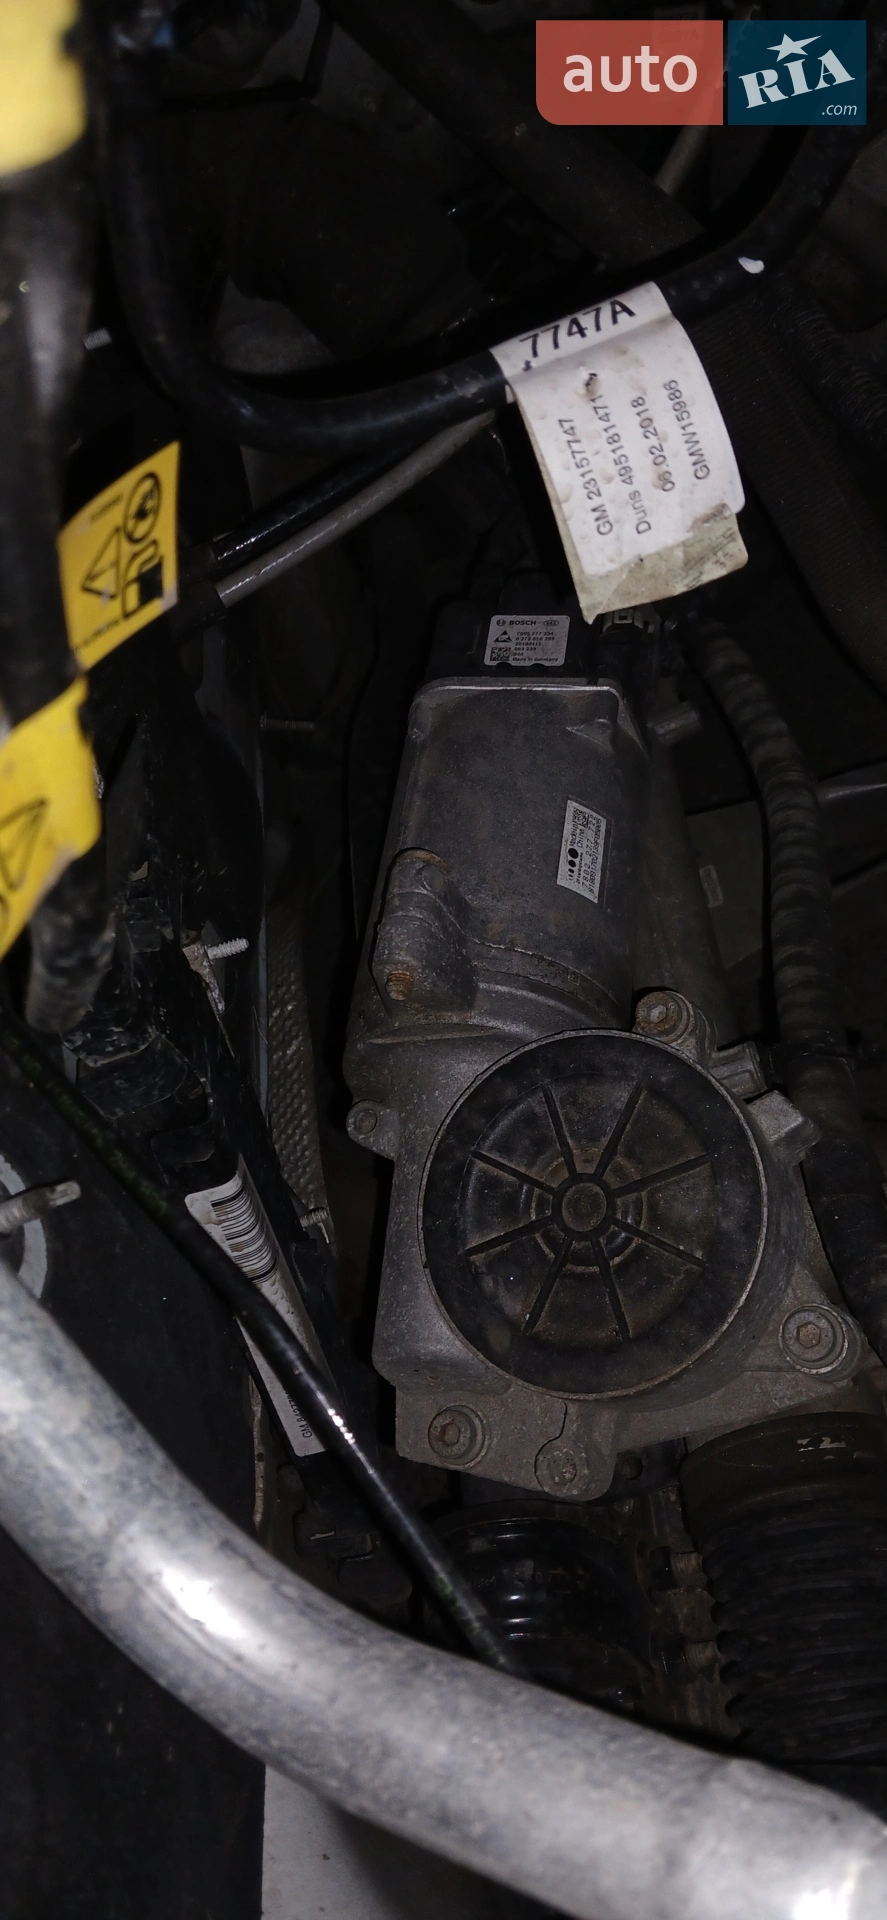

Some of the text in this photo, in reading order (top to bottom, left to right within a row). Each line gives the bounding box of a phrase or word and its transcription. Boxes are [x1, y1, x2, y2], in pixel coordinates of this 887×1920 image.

[520, 300, 635, 359] 7747A
[663, 379, 711, 481] GMW15986
[559, 418, 614, 536] GM 23157747
[629, 490, 652, 535] Duns
[576, 827, 584, 848] China
[299, 1421, 313, 1438] GM
